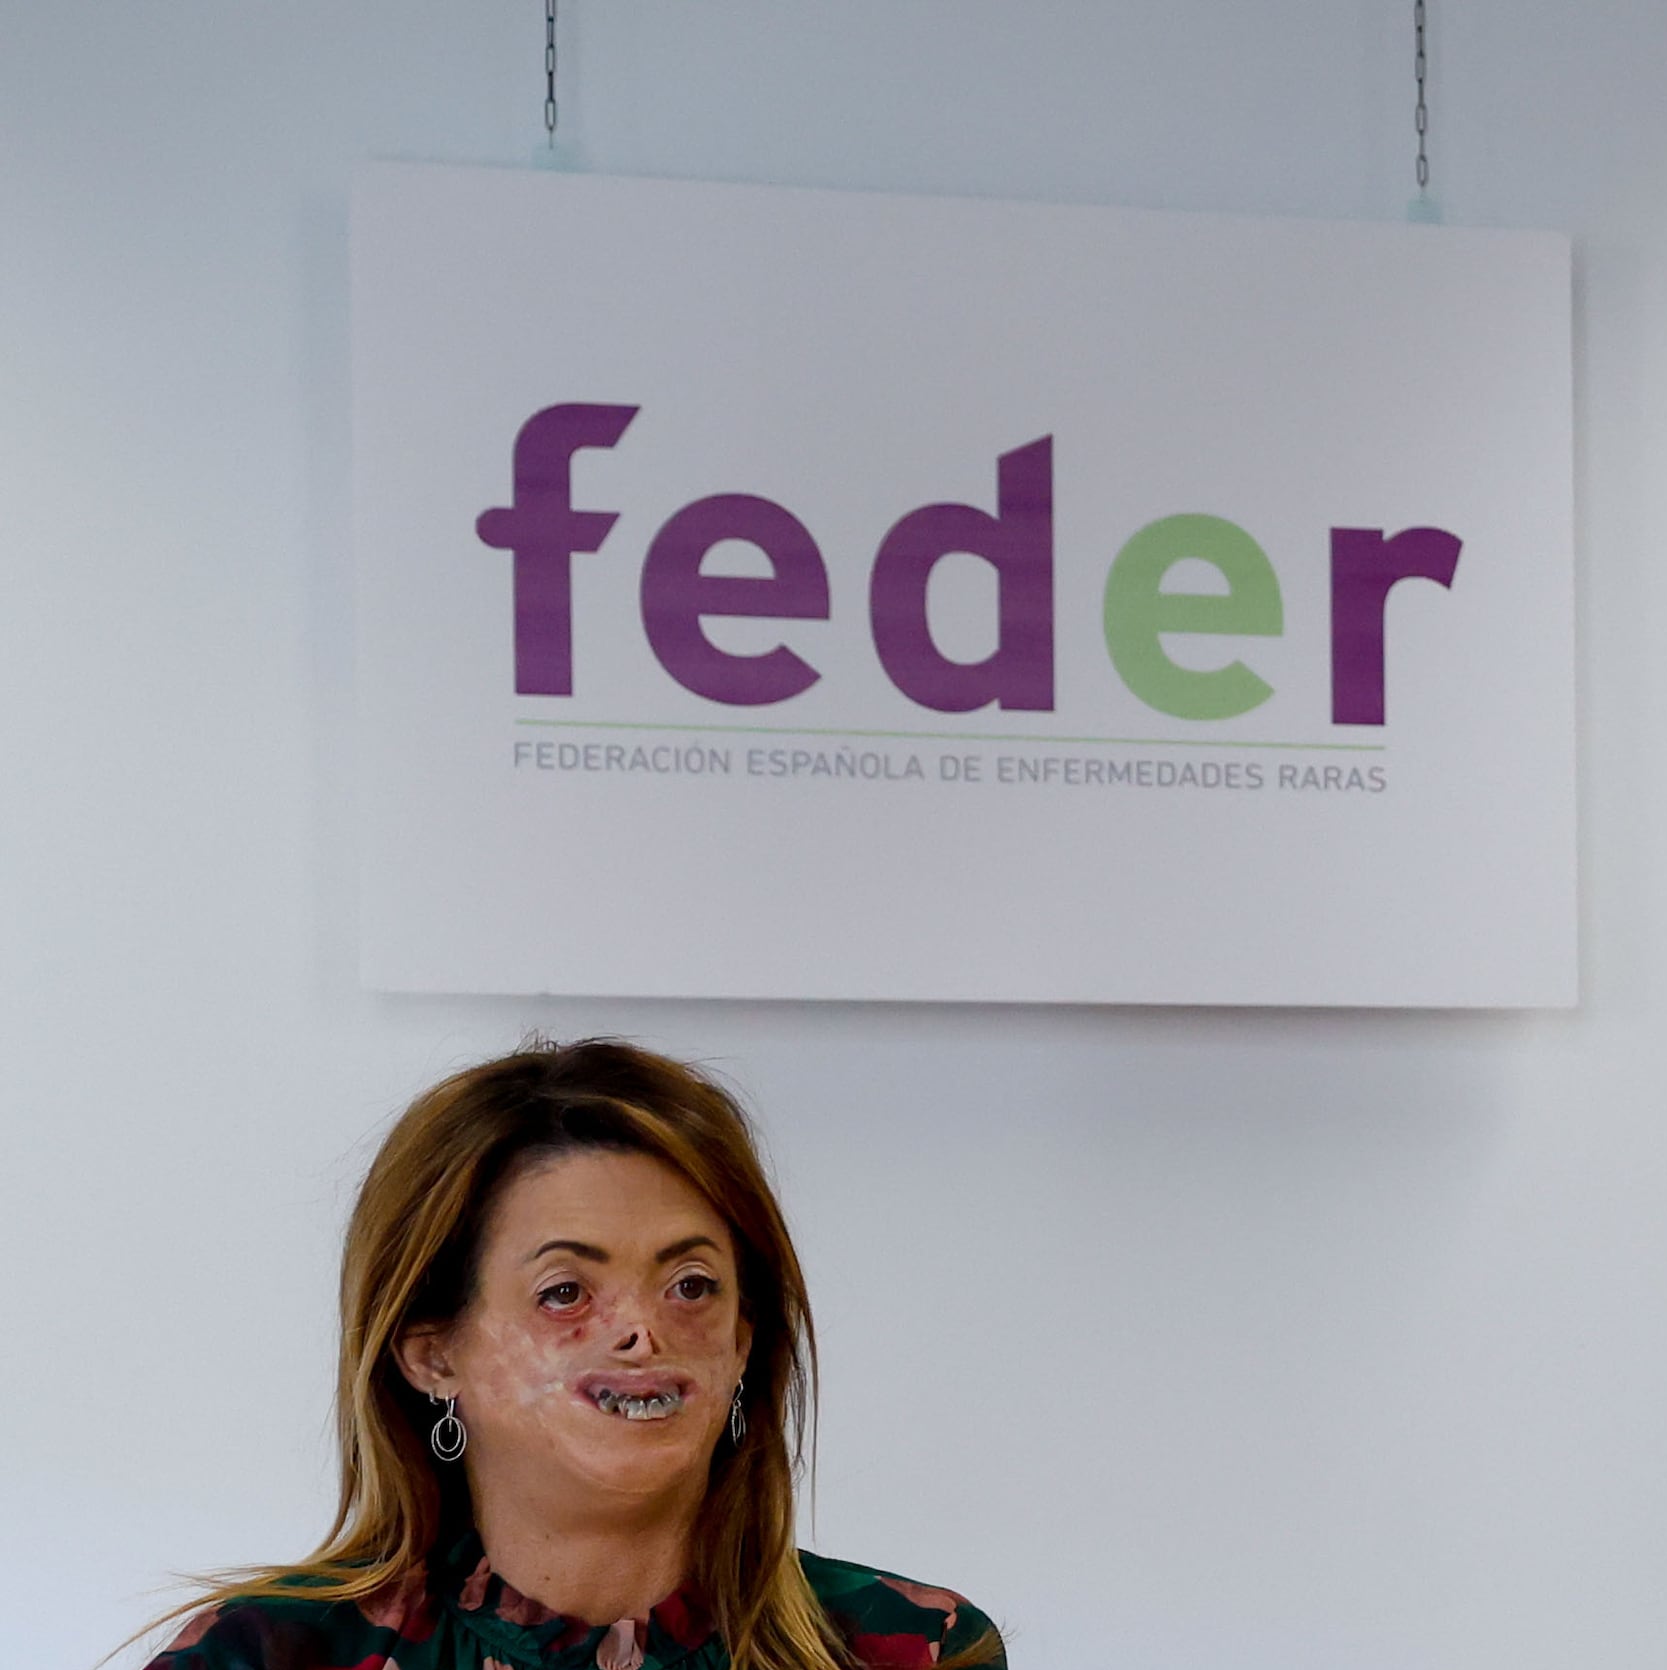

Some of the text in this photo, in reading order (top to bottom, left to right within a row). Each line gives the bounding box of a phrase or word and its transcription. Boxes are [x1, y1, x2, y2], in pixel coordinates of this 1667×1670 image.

[475, 401, 1463, 726] feder
[512, 739, 1388, 794] FEDERACIÓN ESPAÑOLA DE ENFERMEDADES RARAS
